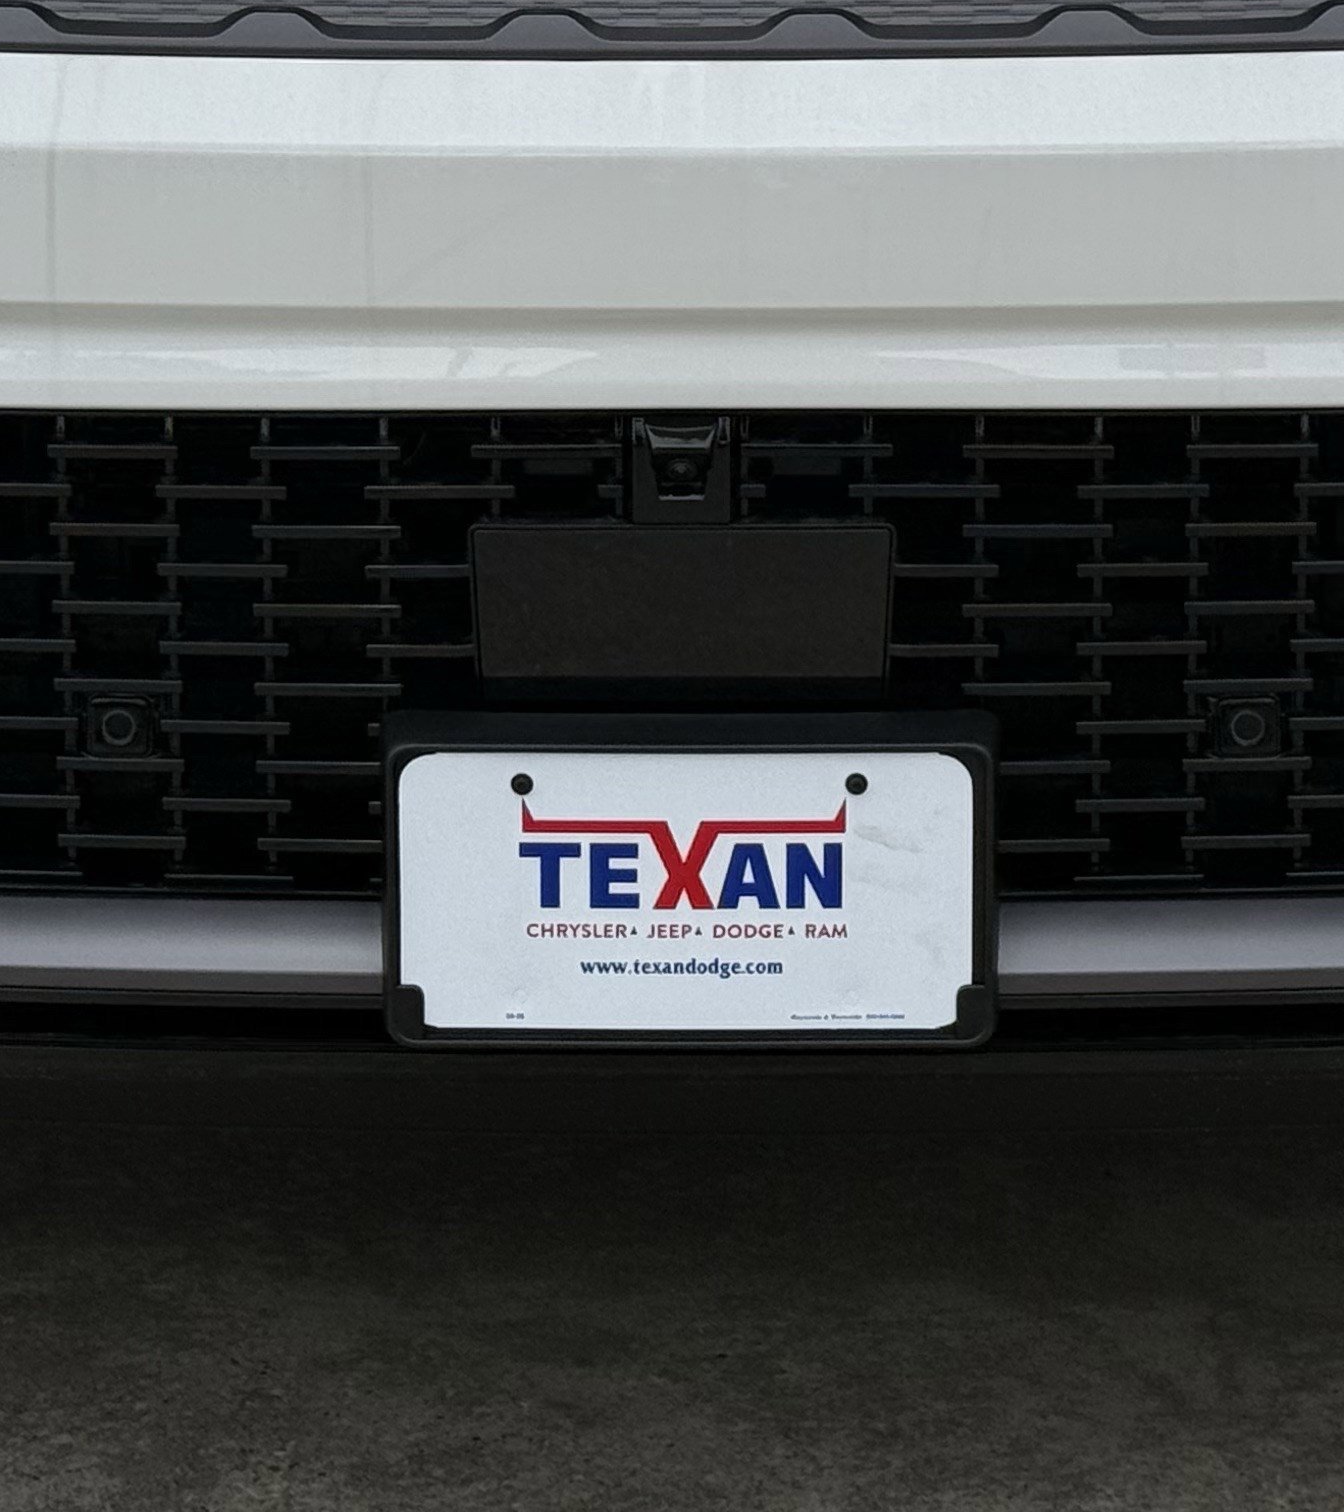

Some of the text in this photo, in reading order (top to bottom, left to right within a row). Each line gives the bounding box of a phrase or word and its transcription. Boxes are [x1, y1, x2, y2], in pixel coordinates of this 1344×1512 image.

[519, 821, 845, 909] TEXAN
[526, 923, 848, 939] CHRYSLER JEEP DODGE RAM
[579, 957, 784, 979] www.texandodge.com
